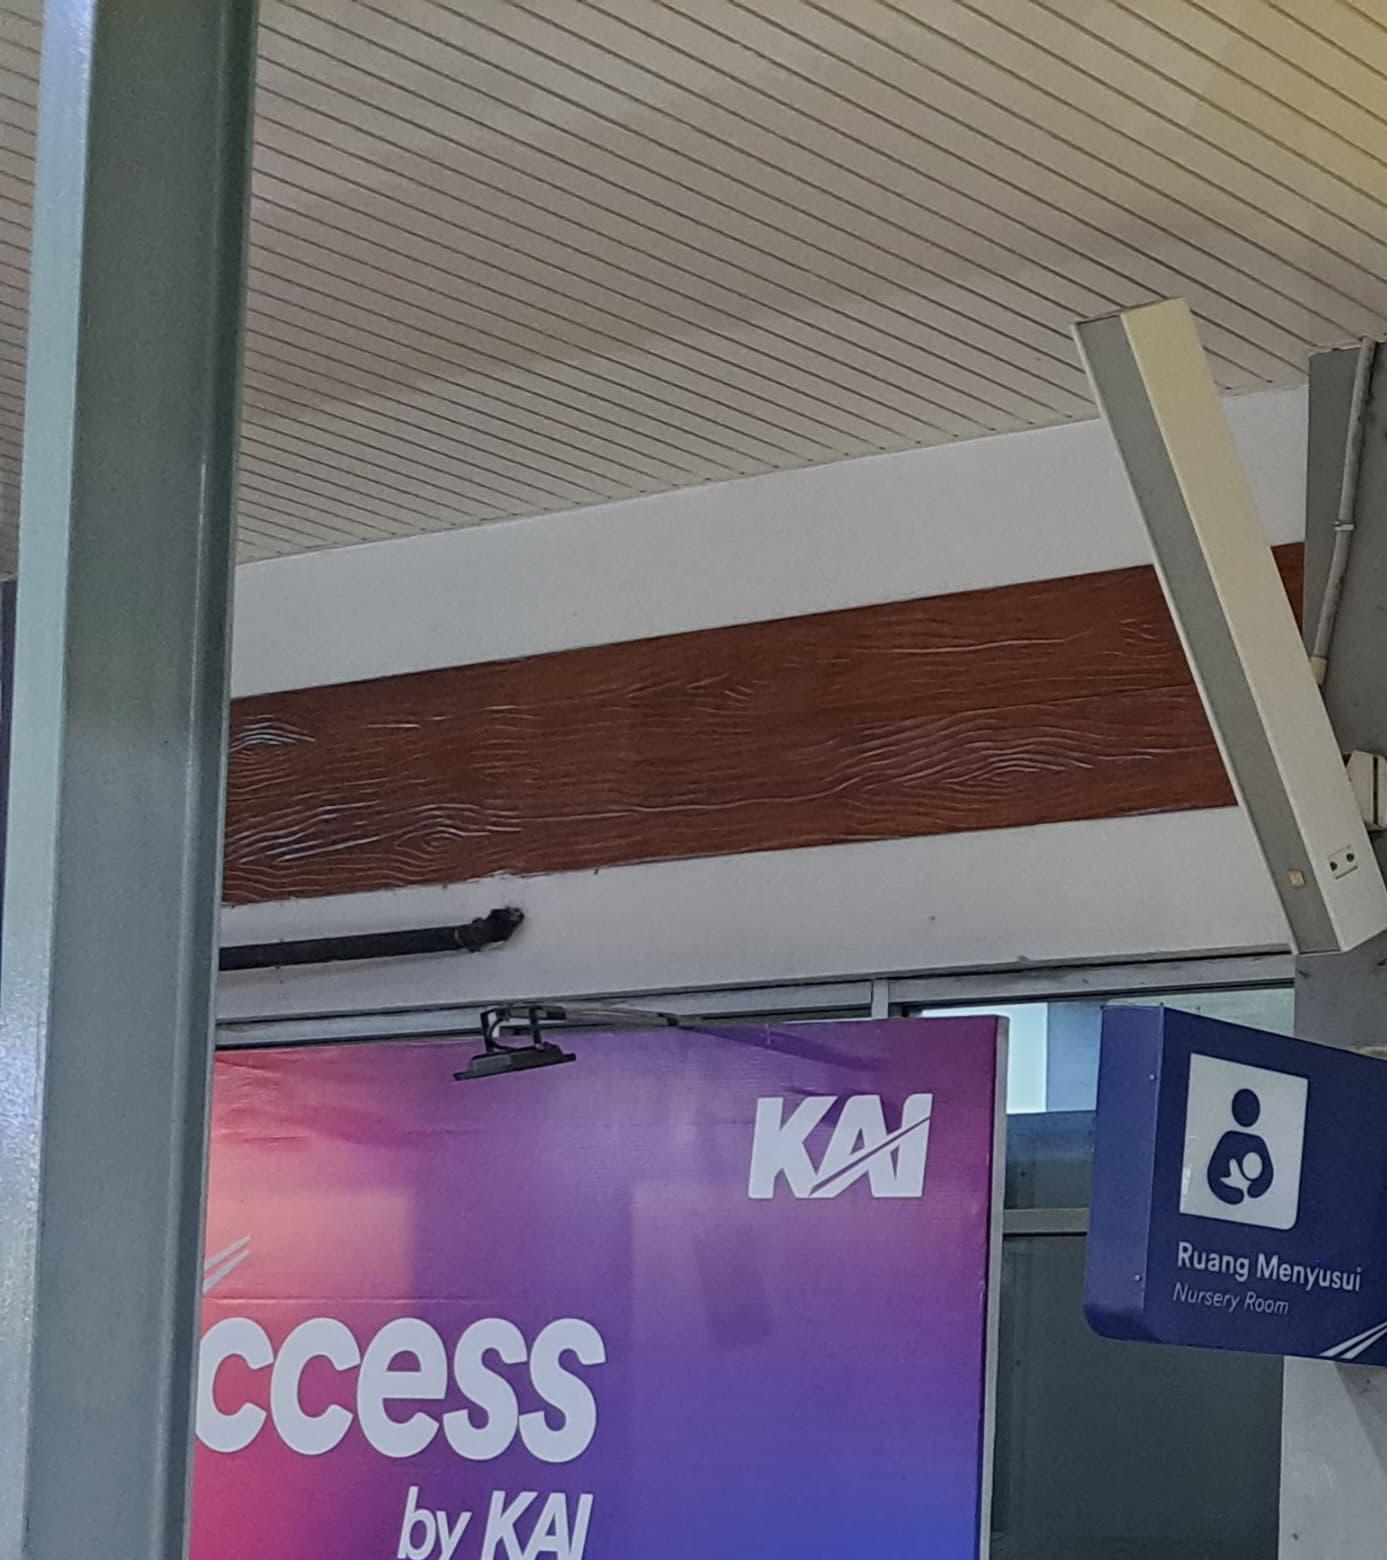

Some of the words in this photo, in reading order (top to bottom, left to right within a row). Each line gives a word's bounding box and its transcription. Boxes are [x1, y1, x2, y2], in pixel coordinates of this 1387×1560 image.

[748, 1093, 933, 1199] KAI
[1172, 1281, 1240, 1312] Nursery
[1244, 1292, 1289, 1315] Room
[1177, 1242, 1250, 1282] Ruang
[1256, 1252, 1363, 1293] Menyusui
[195, 1316, 607, 1462] ccess
